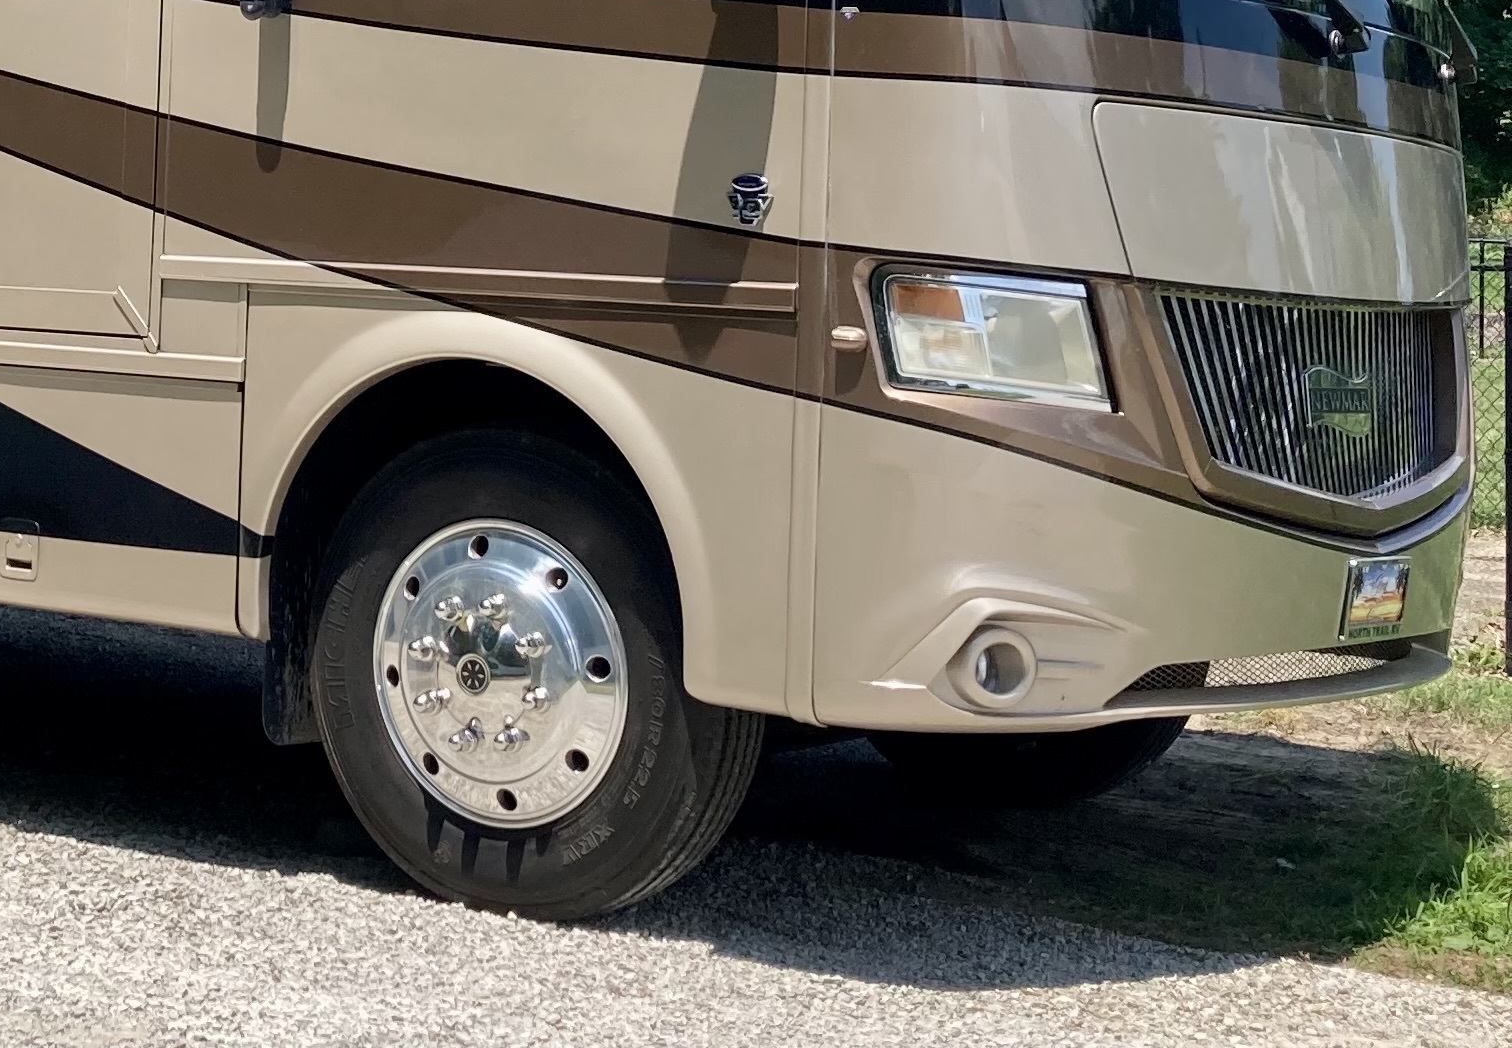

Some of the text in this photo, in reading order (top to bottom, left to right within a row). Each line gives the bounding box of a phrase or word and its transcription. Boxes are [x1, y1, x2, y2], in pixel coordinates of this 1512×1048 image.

[1310, 390, 1369, 412] NEWMAR
[1348, 627, 1371, 639] NORTH
[1372, 625, 1390, 637] TRAIL
